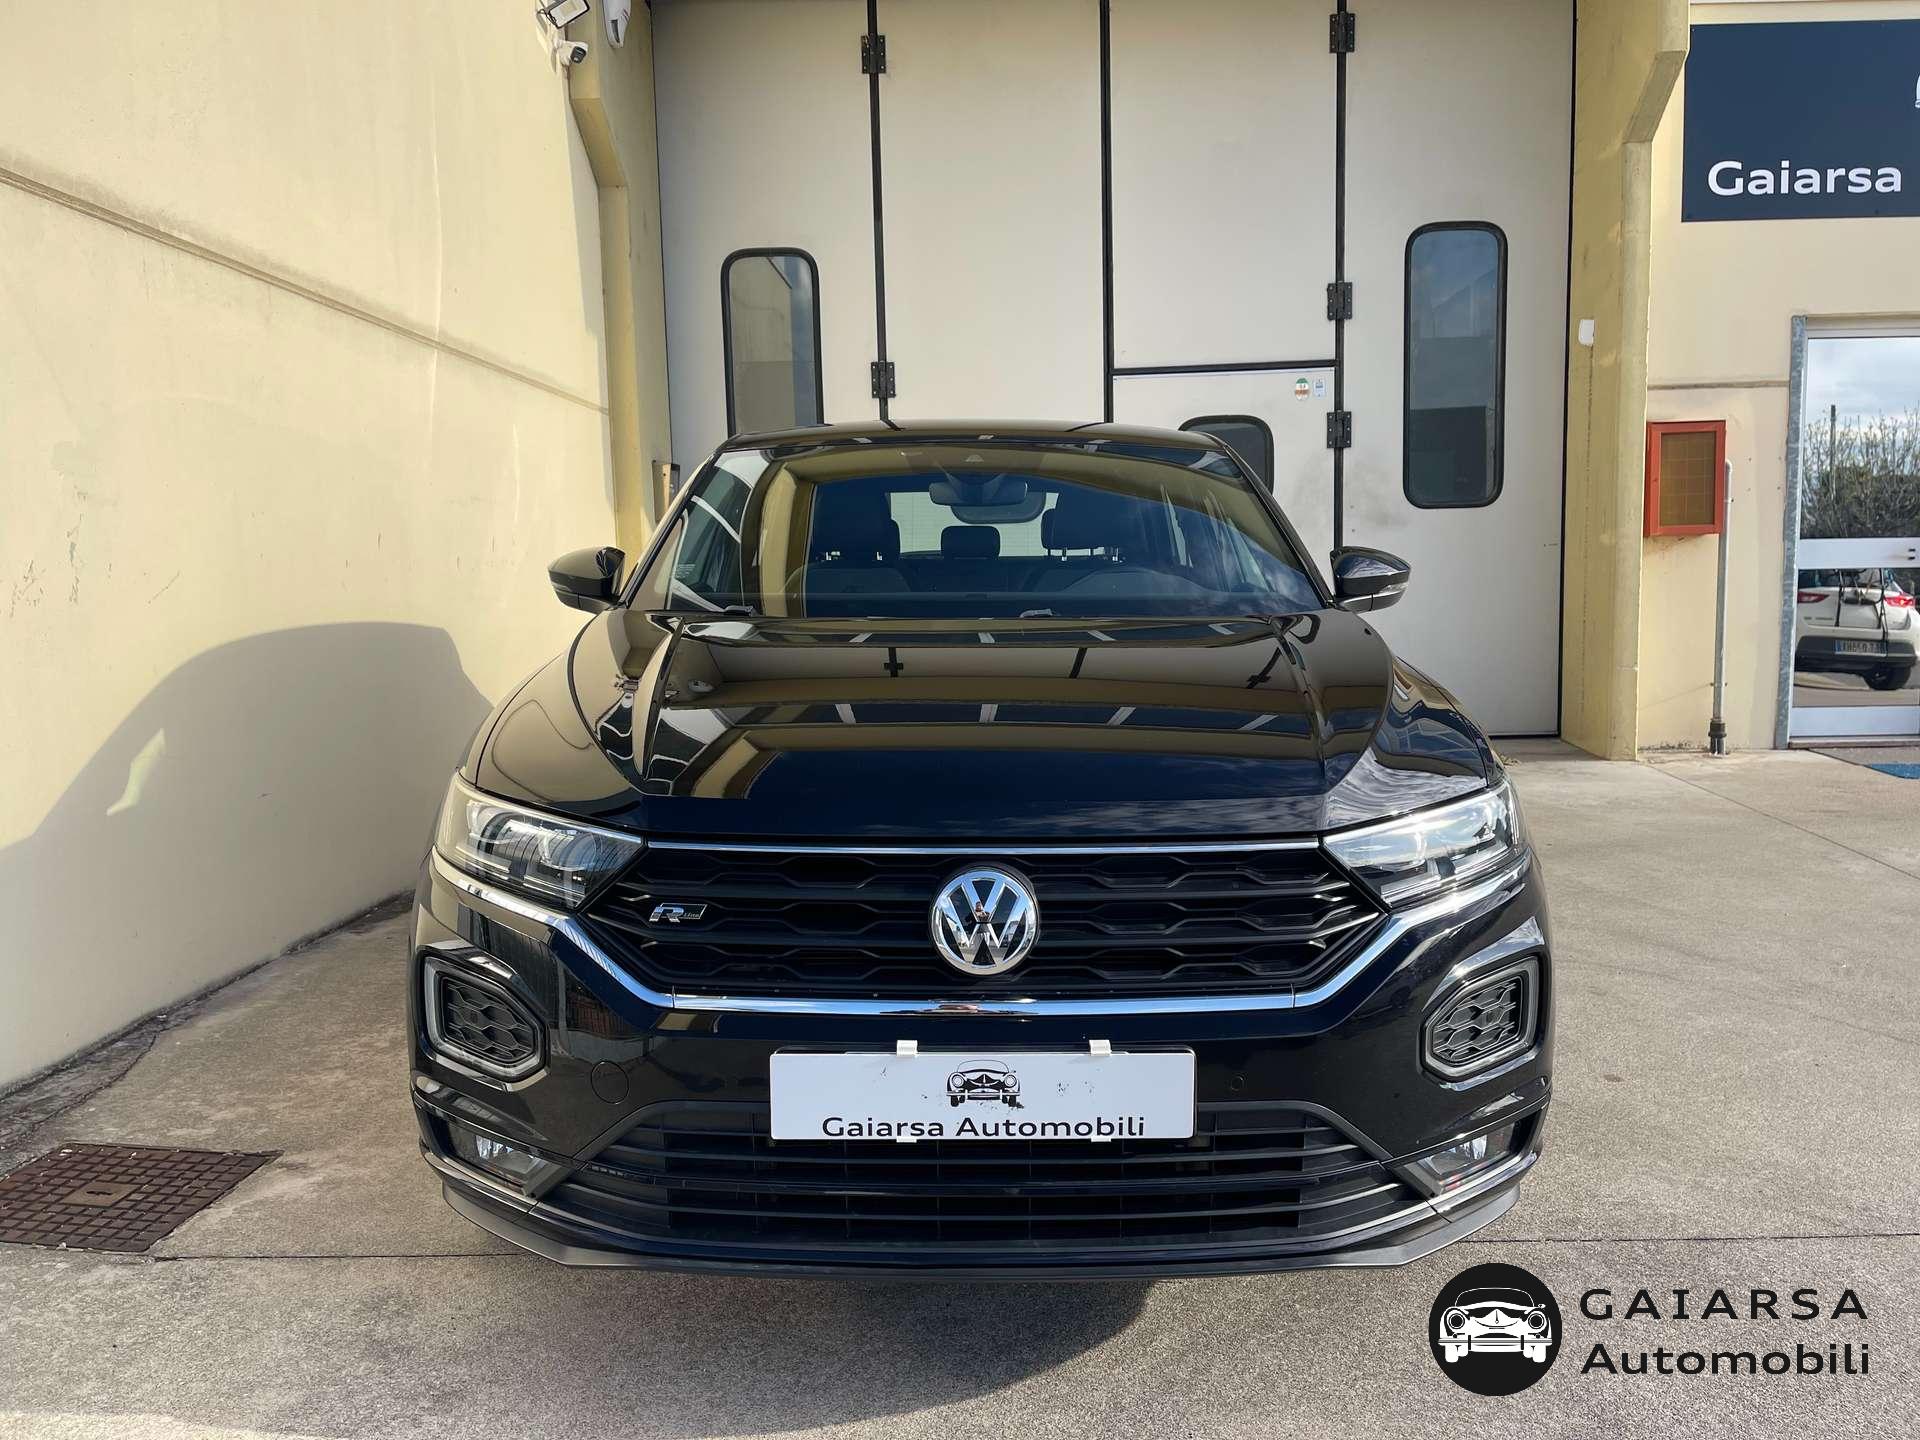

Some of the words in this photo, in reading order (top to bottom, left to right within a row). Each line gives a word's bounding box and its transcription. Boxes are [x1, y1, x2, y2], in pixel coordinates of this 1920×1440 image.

[1707, 160, 1902, 196] Gaiarsa
[822, 1117, 944, 1137] Gaiarsa
[955, 1116, 1144, 1137] Automobili
